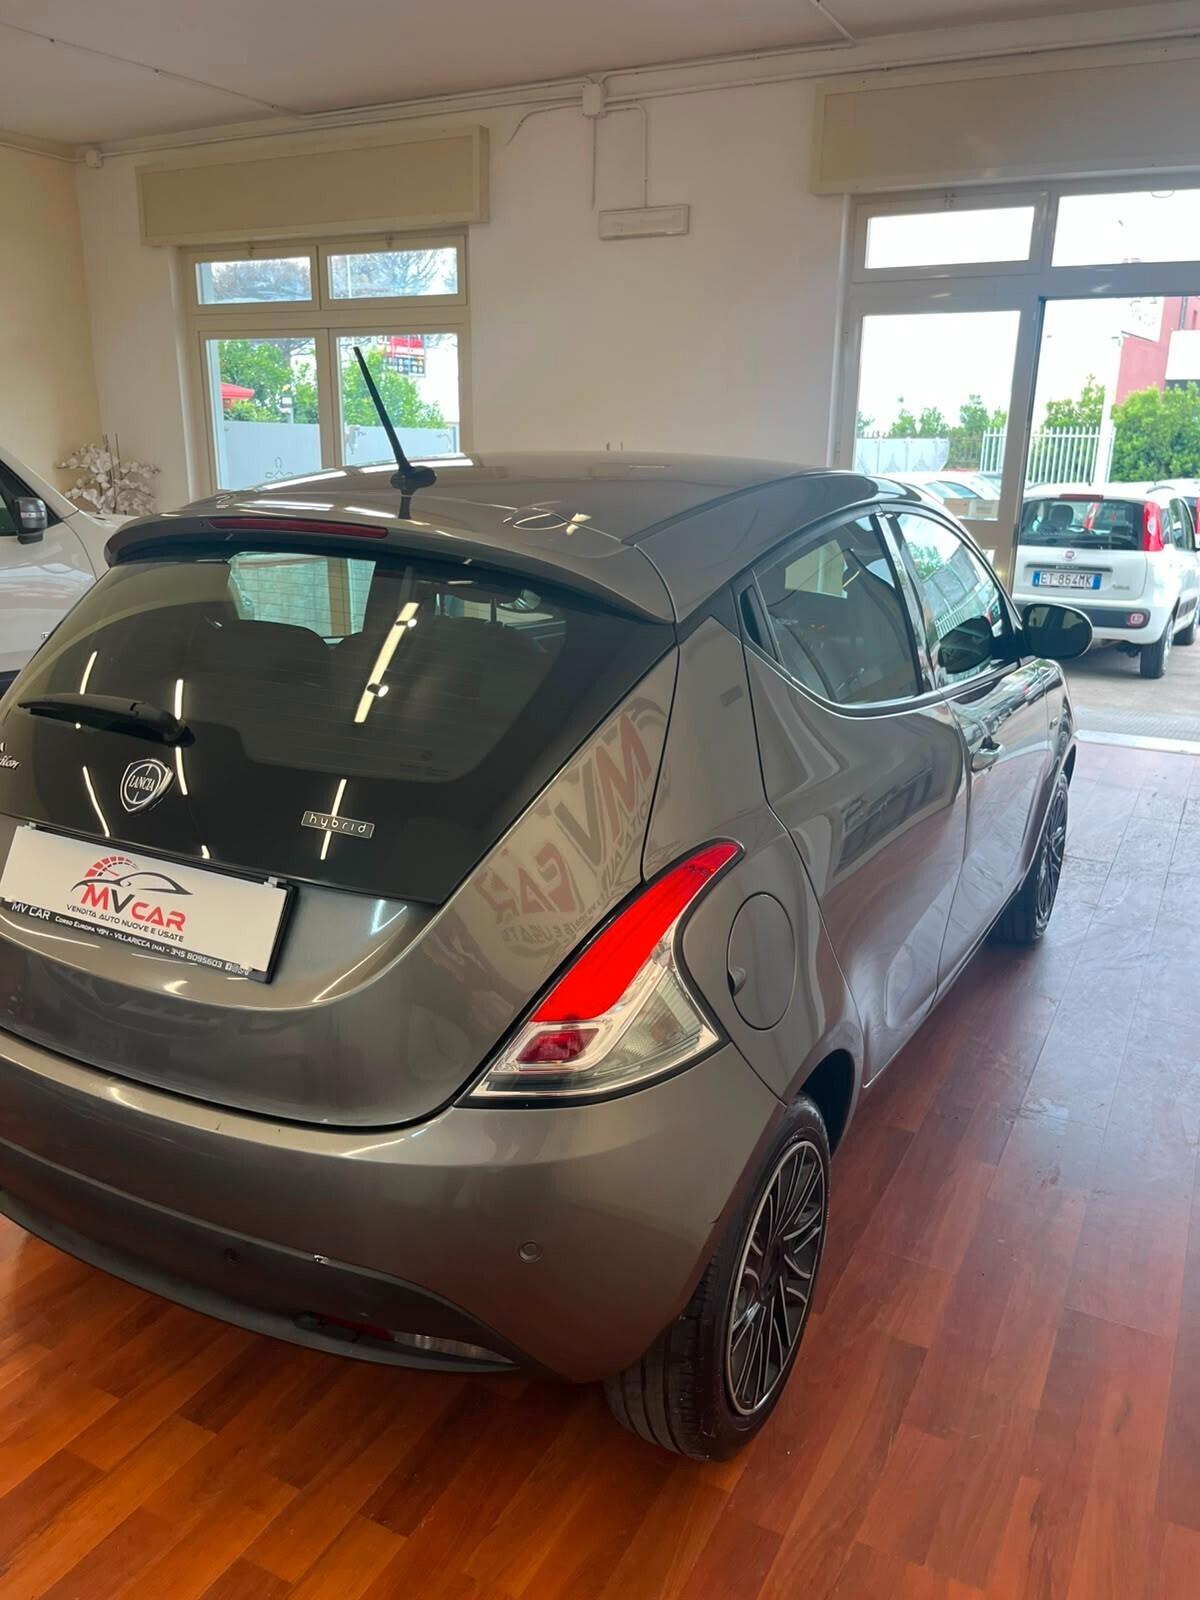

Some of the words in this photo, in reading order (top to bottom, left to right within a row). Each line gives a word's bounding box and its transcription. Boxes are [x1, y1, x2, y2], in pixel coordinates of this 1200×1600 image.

[128, 775, 156, 792] LANCIA
[309, 813, 367, 833] hybrid
[11, 902, 28, 913] MV
[28, 905, 51, 920] CAR
[113, 932, 151, 948] VILLARICCA
[170, 947, 186, 959] 345
[66, 904, 97, 918] VENDITA
[98, 913, 120, 925] AUTO
[121, 920, 149, 934] NUOVE
[150, 927, 156, 935] E
[157, 929, 184, 942] USATE
